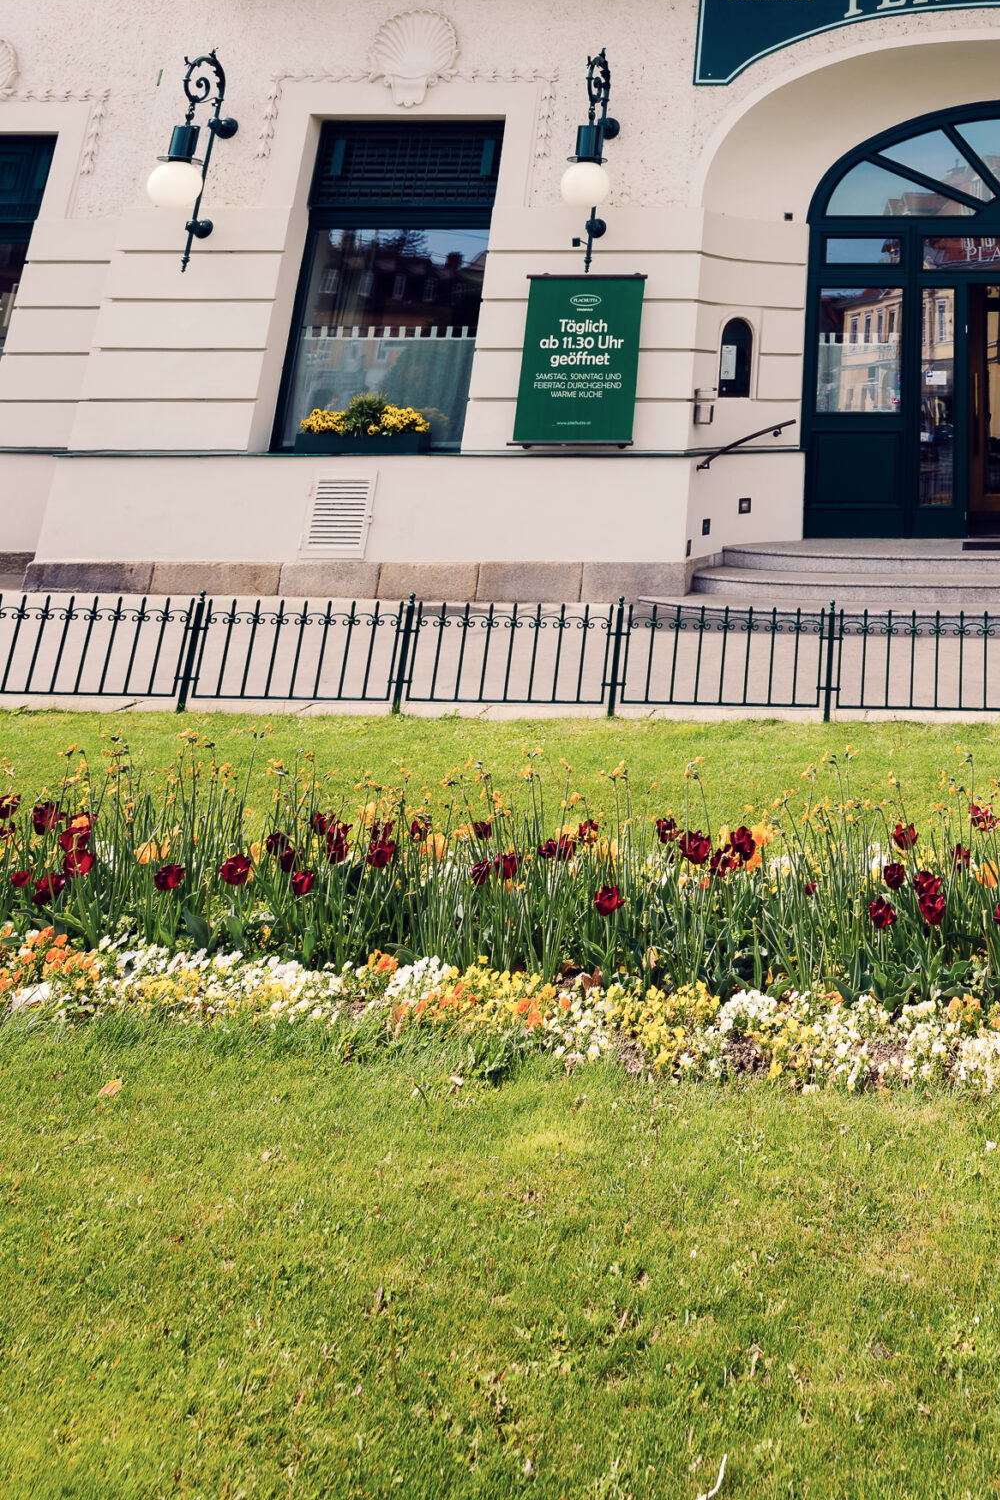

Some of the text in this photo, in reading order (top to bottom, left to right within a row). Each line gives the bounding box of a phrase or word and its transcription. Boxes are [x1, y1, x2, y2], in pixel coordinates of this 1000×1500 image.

[559, 319, 608, 334] Täglich
[539, 335, 624, 349] ab 11.30 Uhr
[550, 351, 610, 367] geöffnet
